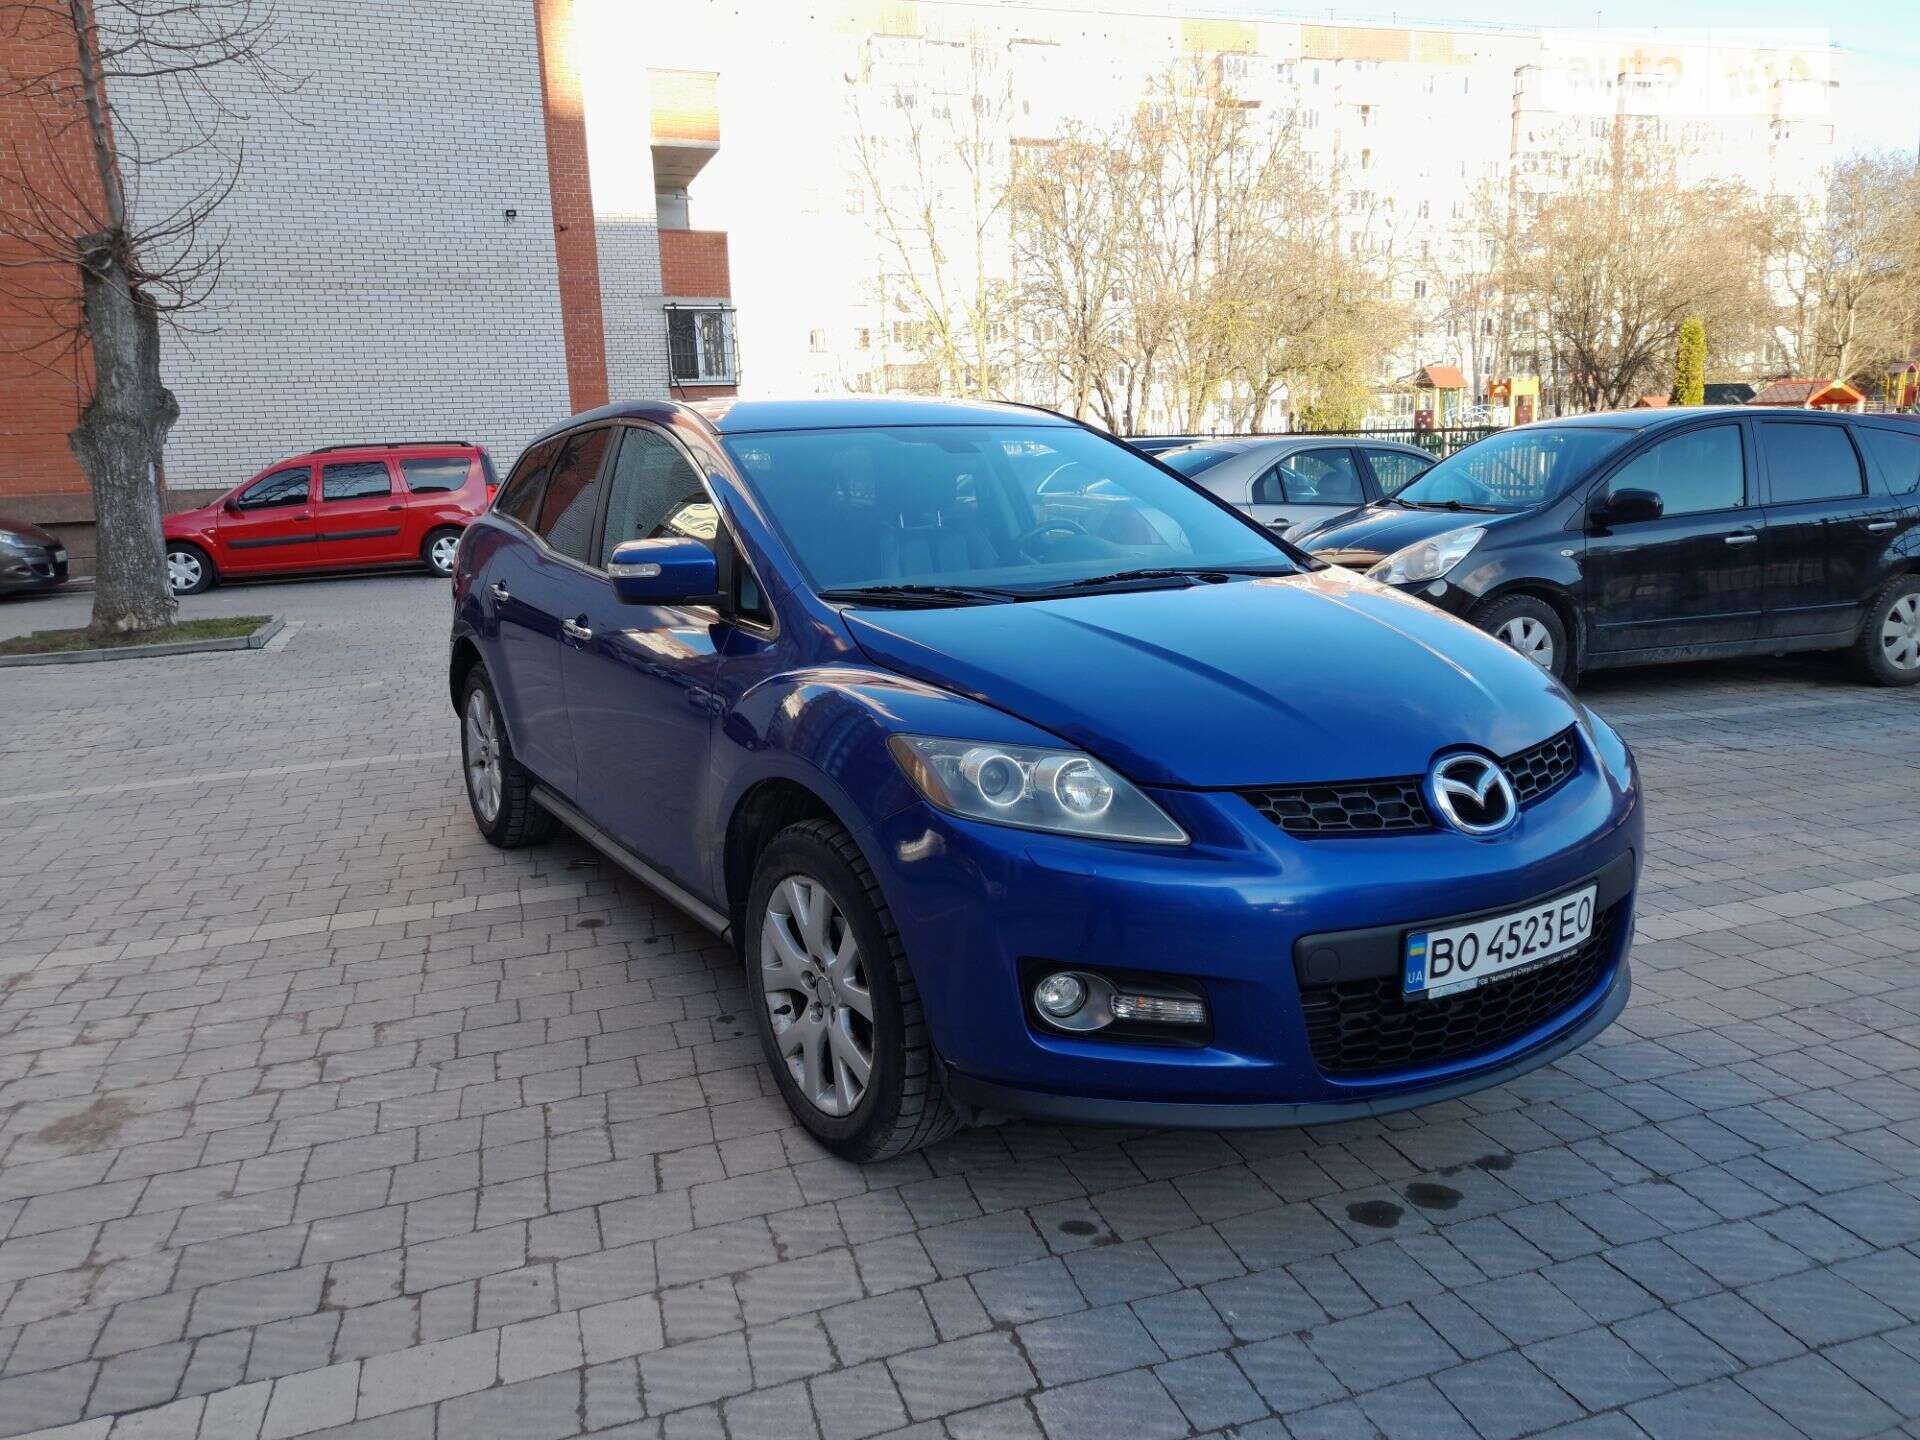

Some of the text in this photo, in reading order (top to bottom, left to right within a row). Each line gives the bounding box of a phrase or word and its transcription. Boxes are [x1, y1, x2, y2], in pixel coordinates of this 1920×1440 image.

[1430, 933, 1479, 978] BO
[1487, 910, 1554, 963] 4523
[1560, 896, 1591, 943] EO
[1408, 970, 1424, 984] UA
